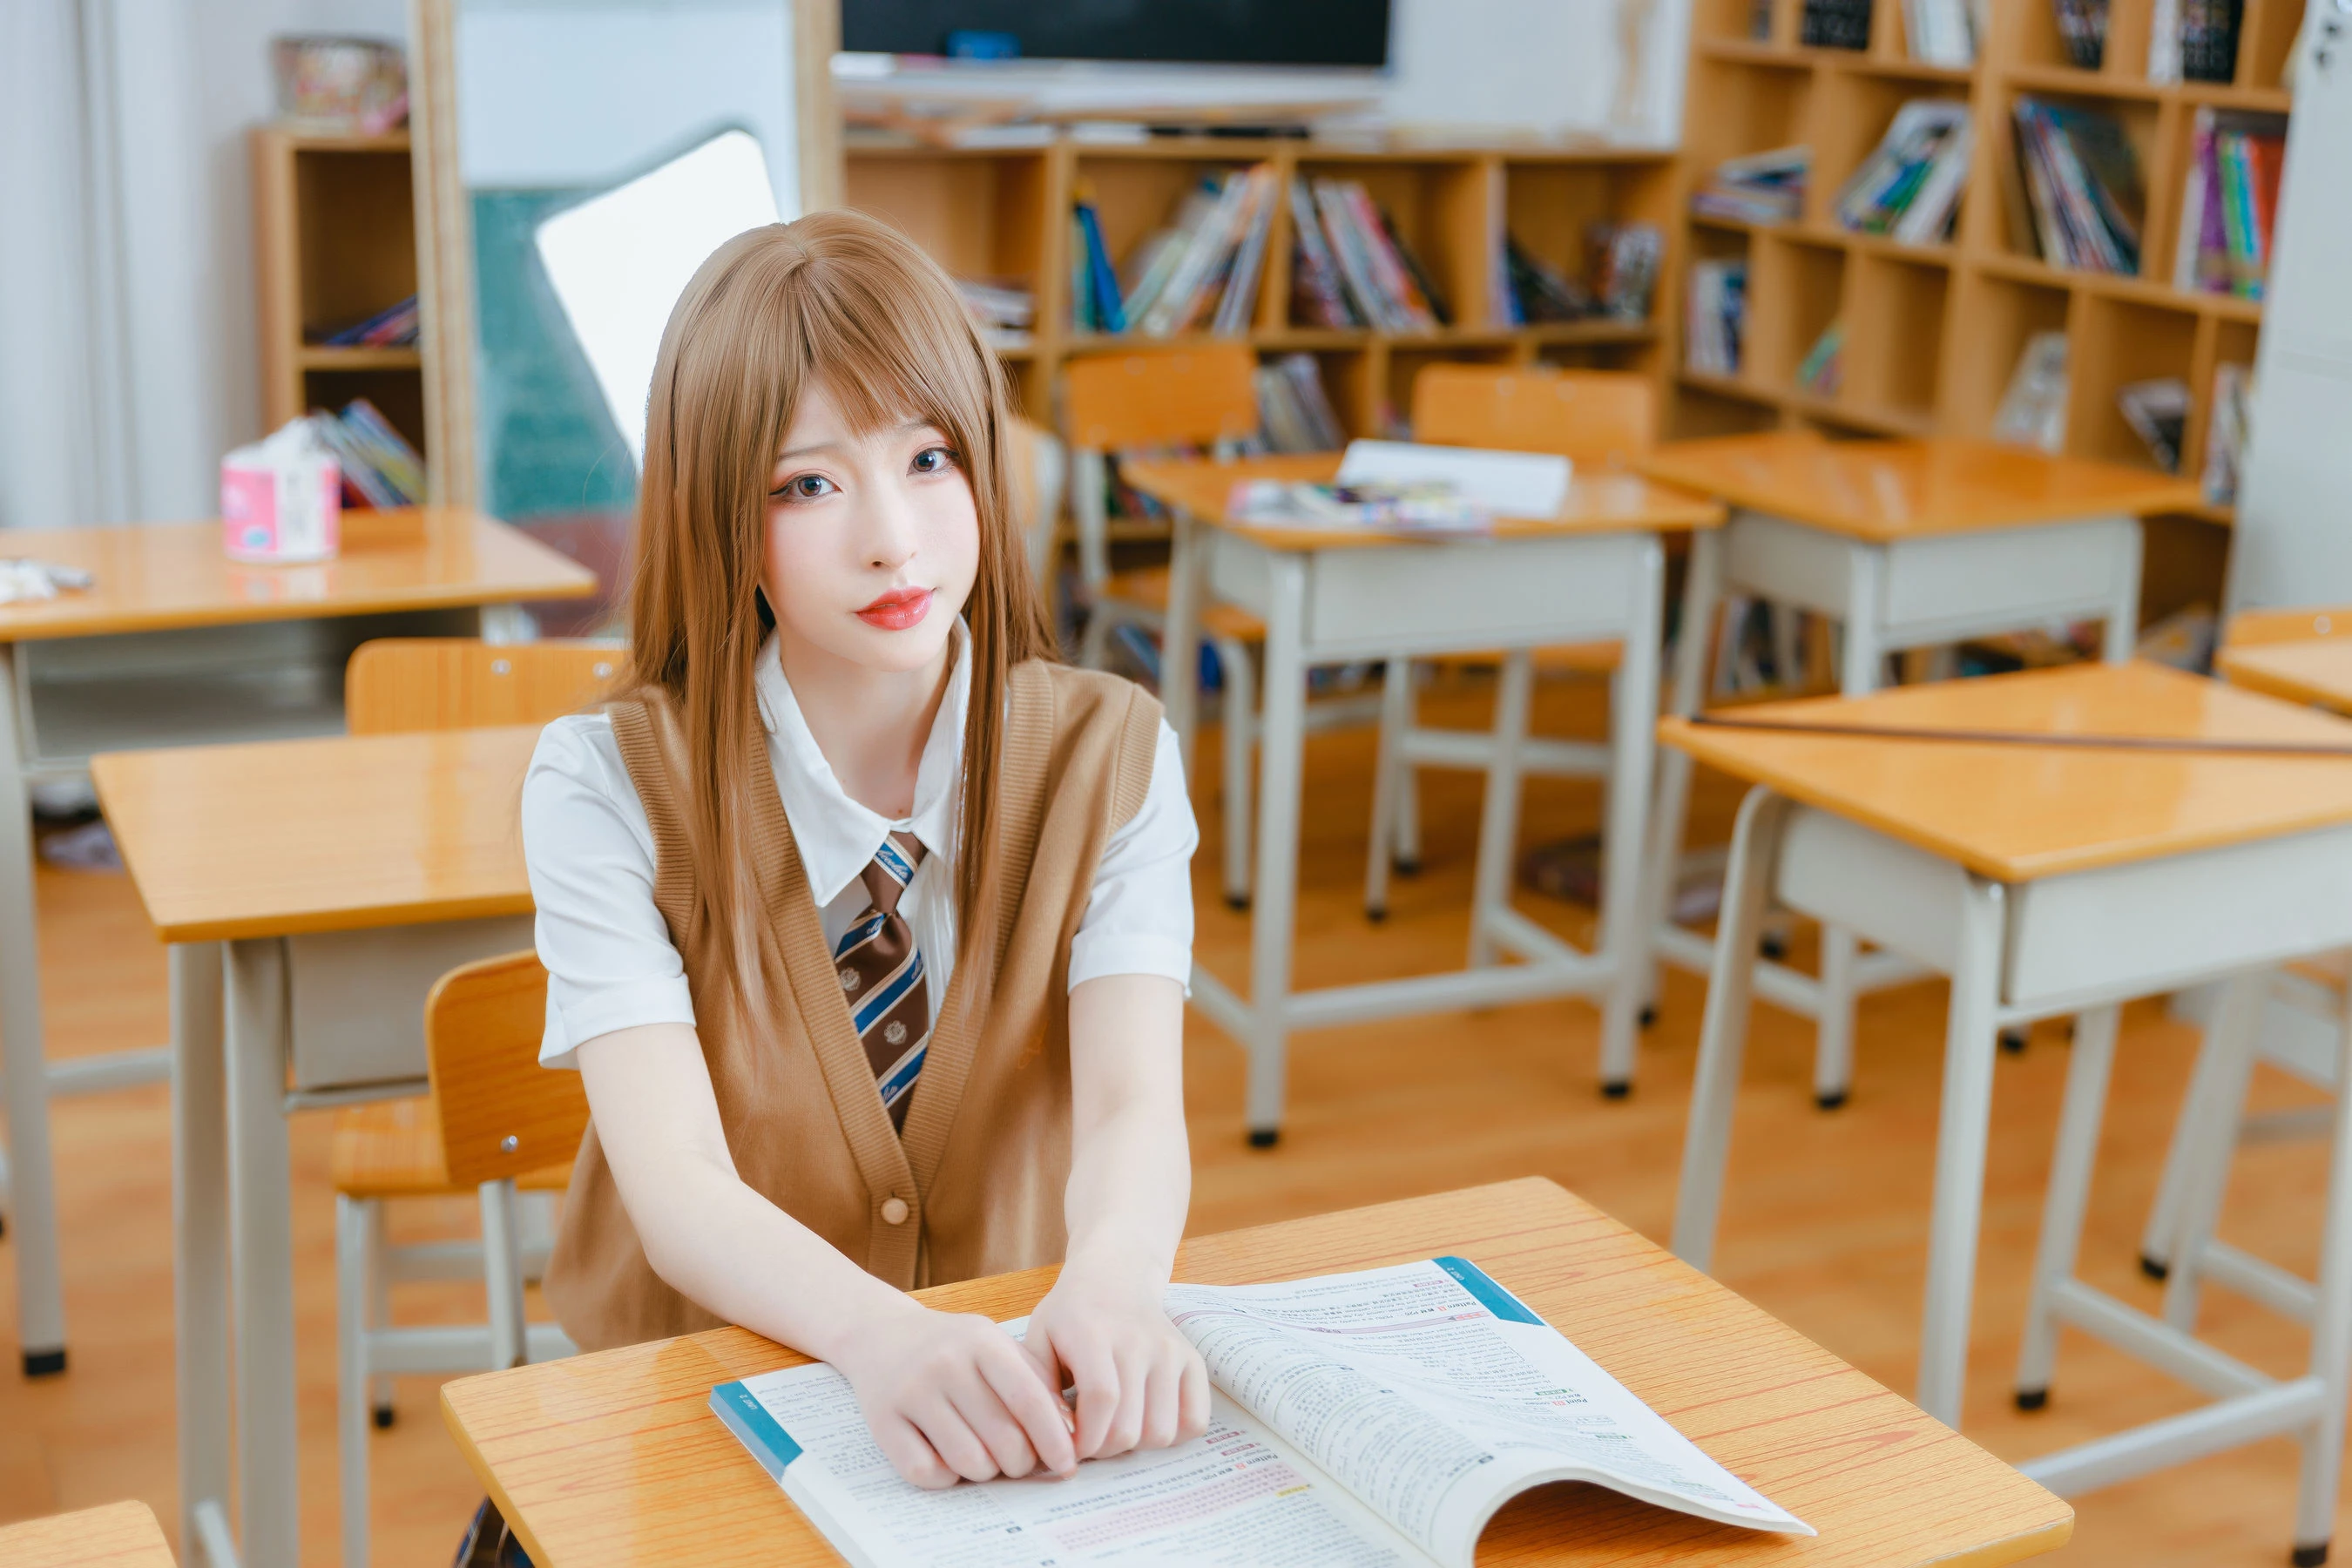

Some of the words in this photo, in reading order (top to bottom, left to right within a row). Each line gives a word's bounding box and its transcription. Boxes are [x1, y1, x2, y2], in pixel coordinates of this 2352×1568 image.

[742, 1399, 758, 1409] UNIT
[1566, 1397, 1588, 1406] Point
[1246, 1455, 1278, 1465] Pattern
